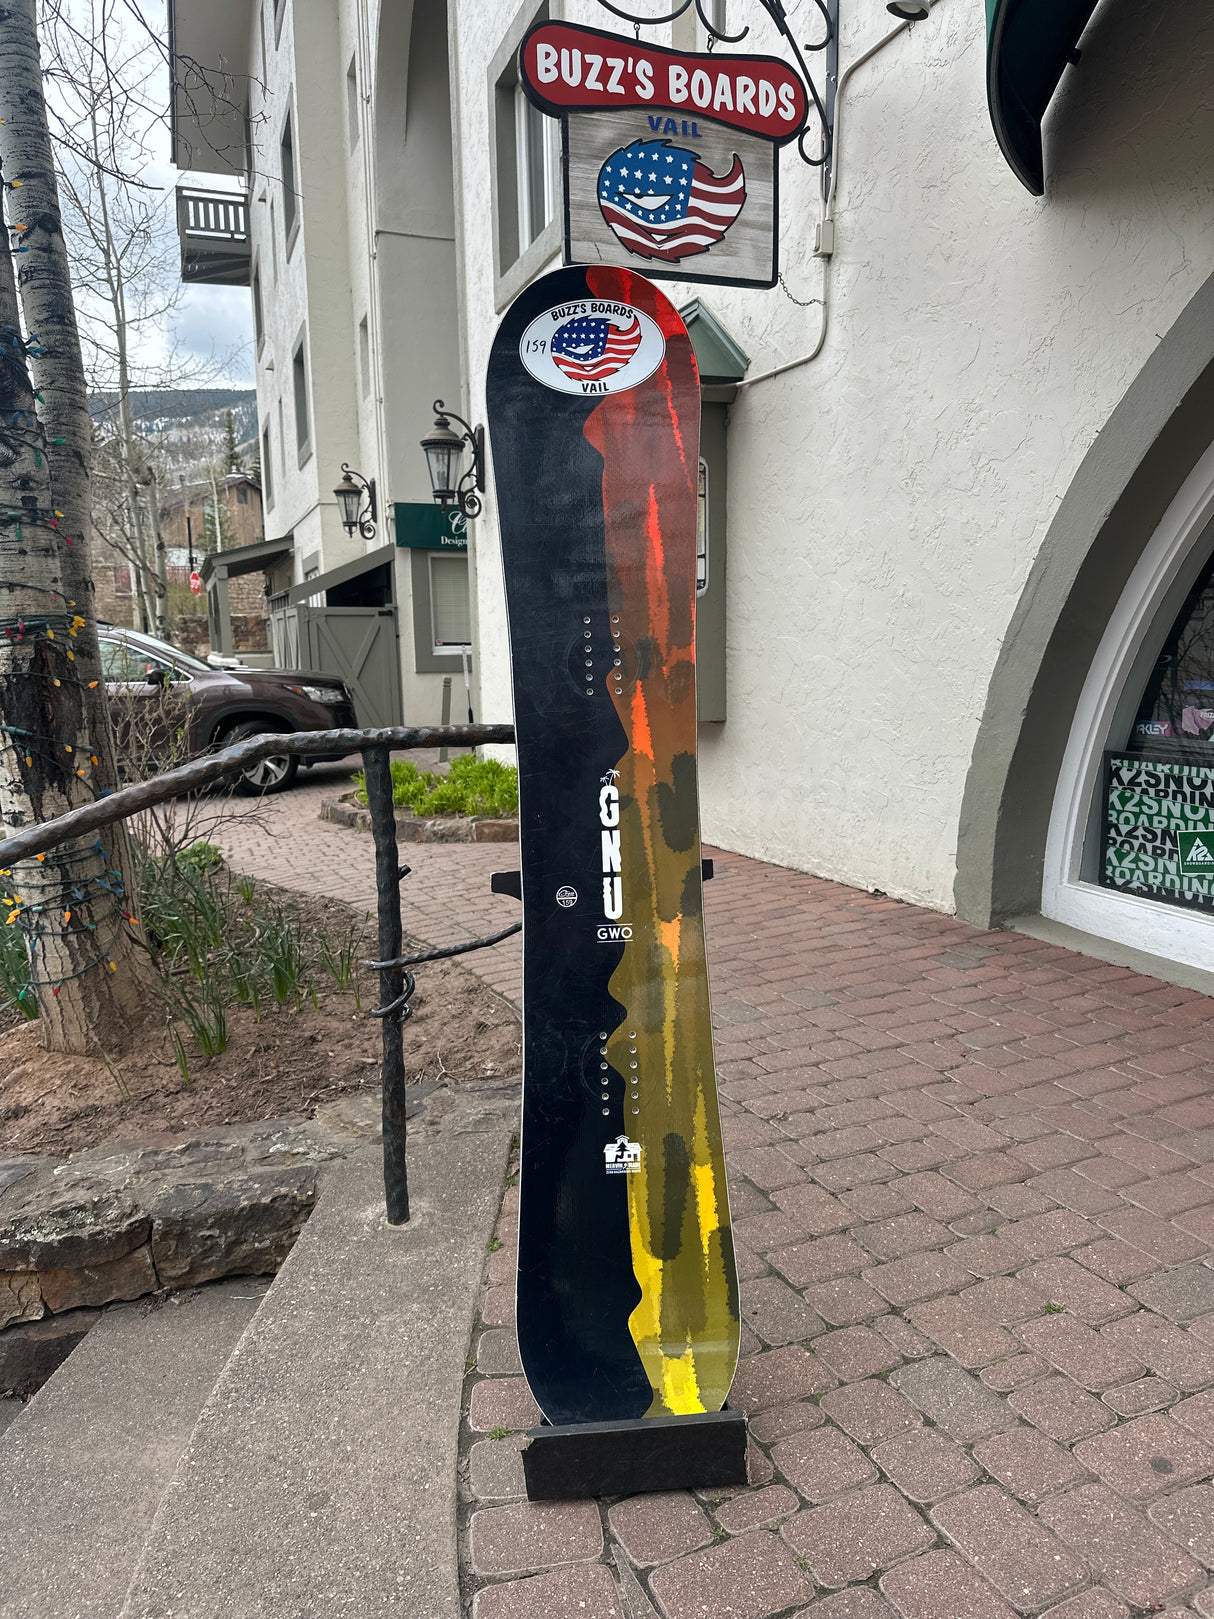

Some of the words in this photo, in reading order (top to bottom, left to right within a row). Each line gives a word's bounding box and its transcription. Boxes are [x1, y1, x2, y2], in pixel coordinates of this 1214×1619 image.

[536, 43, 654, 100] BUZZ'S
[668, 65, 796, 121] BOARDS
[648, 115, 702, 138] VAIL
[551, 303, 587, 321] BUZZ'S
[591, 303, 634, 319] BOARDS
[526, 340, 546, 355] 159
[582, 382, 609, 393] VAIL
[1111, 766, 1214, 791] K2SNO
[599, 785, 623, 920] GNU
[1105, 866, 1214, 896] BOARDIN
[597, 926, 633, 940] GWO
